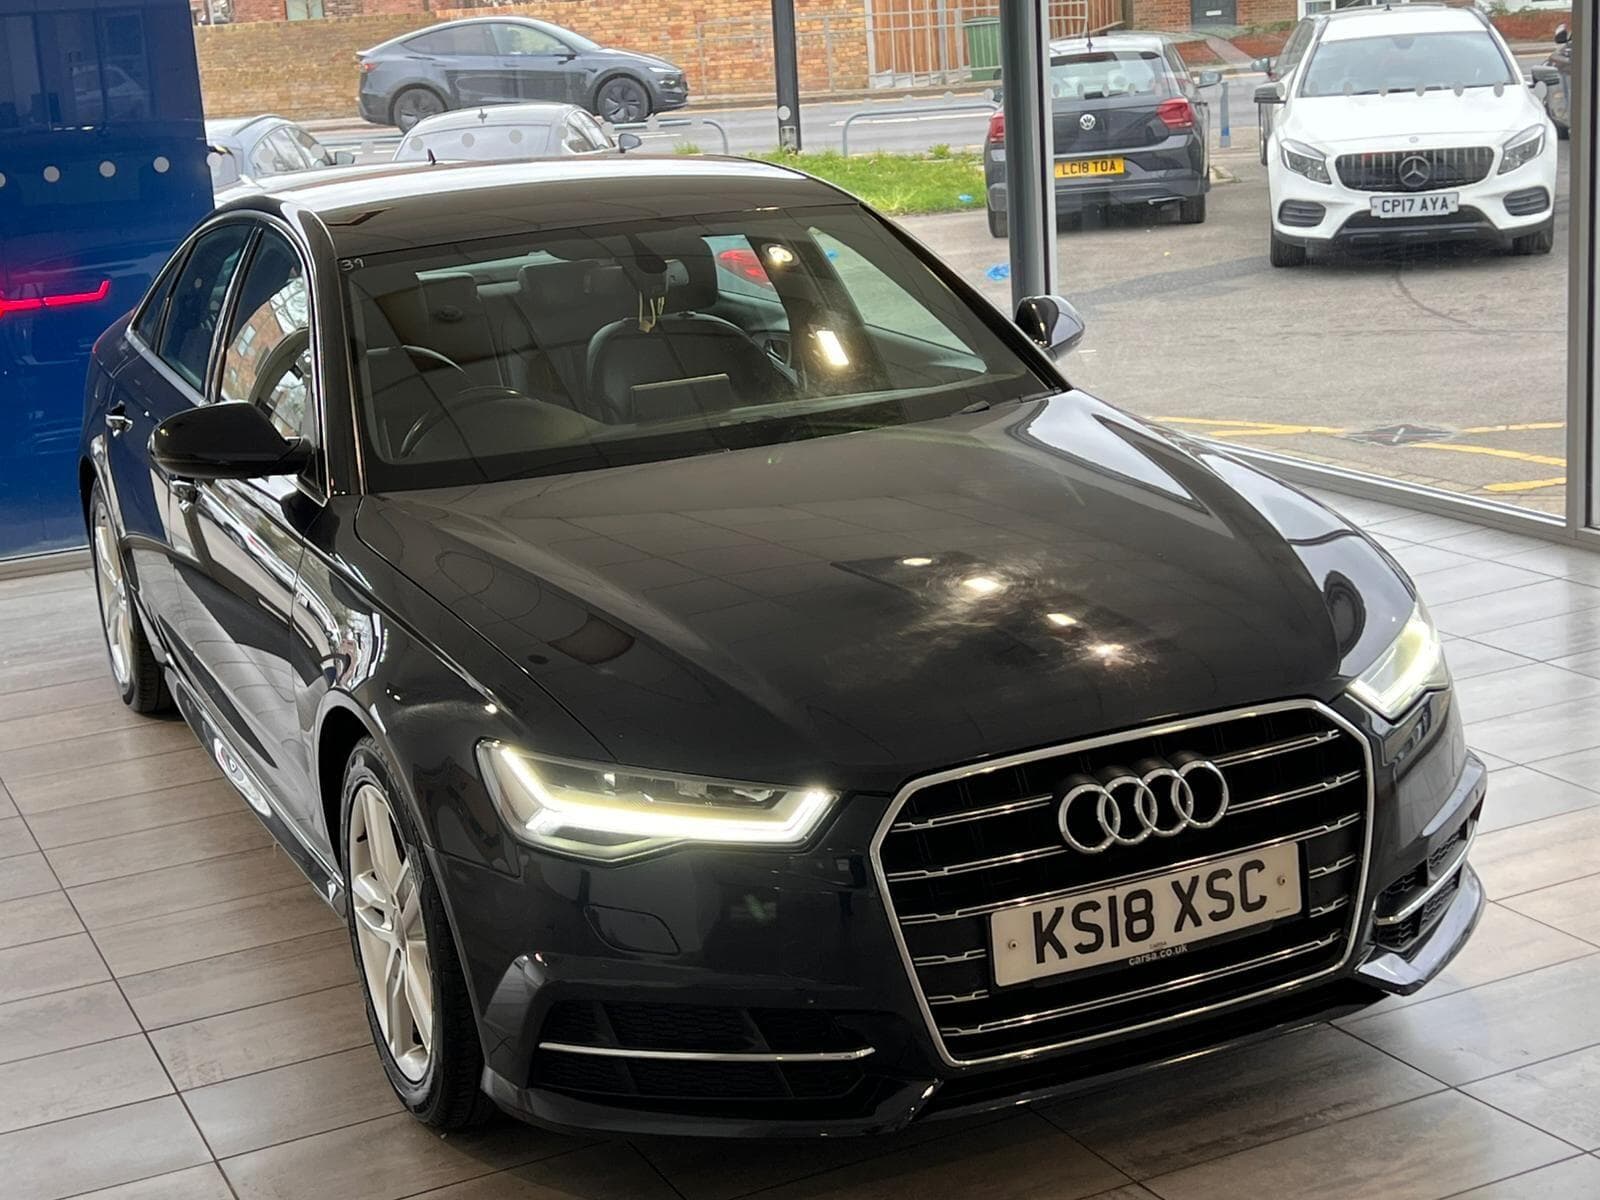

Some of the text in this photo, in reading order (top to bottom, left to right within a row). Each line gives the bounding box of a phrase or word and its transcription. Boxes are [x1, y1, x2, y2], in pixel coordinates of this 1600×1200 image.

[1062, 159, 1117, 175] LC18 TOA
[1382, 197, 1448, 213] CP17 AYA
[1032, 859, 1268, 965] KS18 XSC
[1128, 944, 1189, 966] carsa.co.uk
